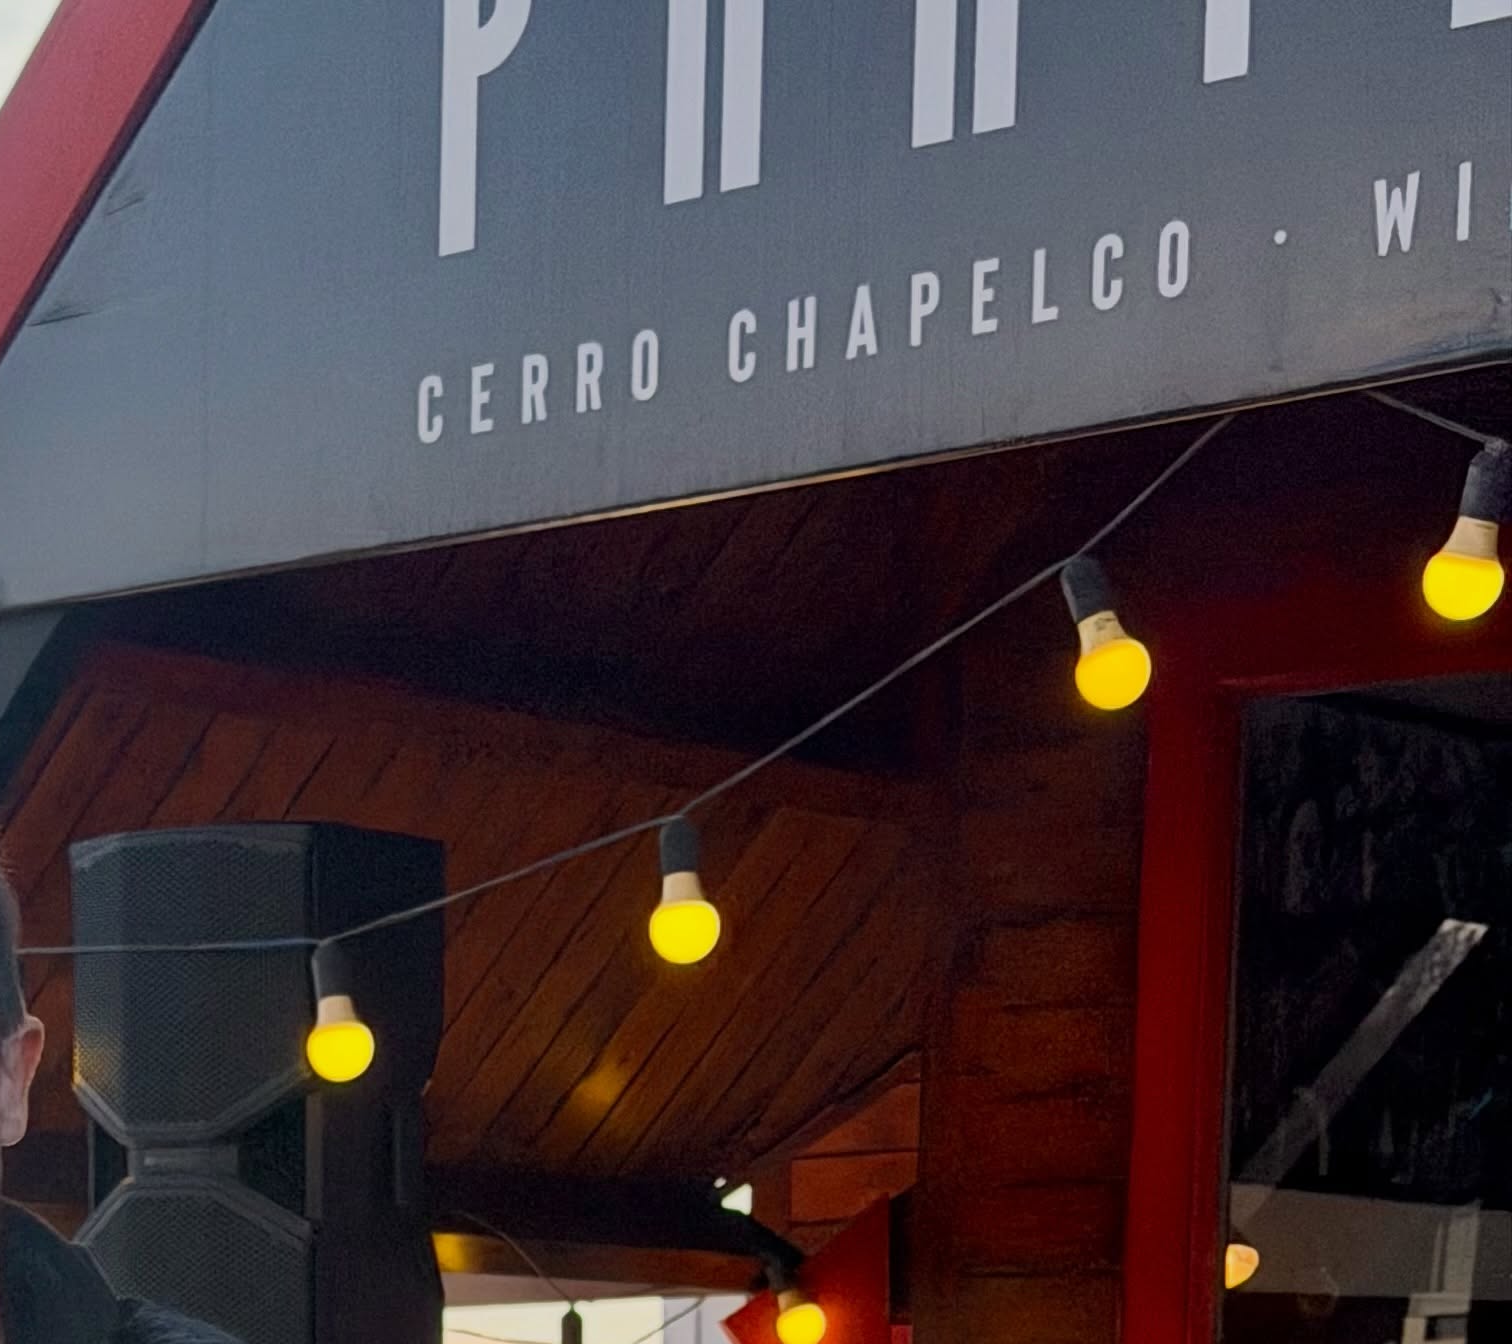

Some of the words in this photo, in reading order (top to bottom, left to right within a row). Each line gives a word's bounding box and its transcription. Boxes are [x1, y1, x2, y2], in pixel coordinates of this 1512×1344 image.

[418, 329, 659, 444] CERRO
[728, 220, 1190, 383] CHAPELCO
[1373, 161, 1512, 257] WI
